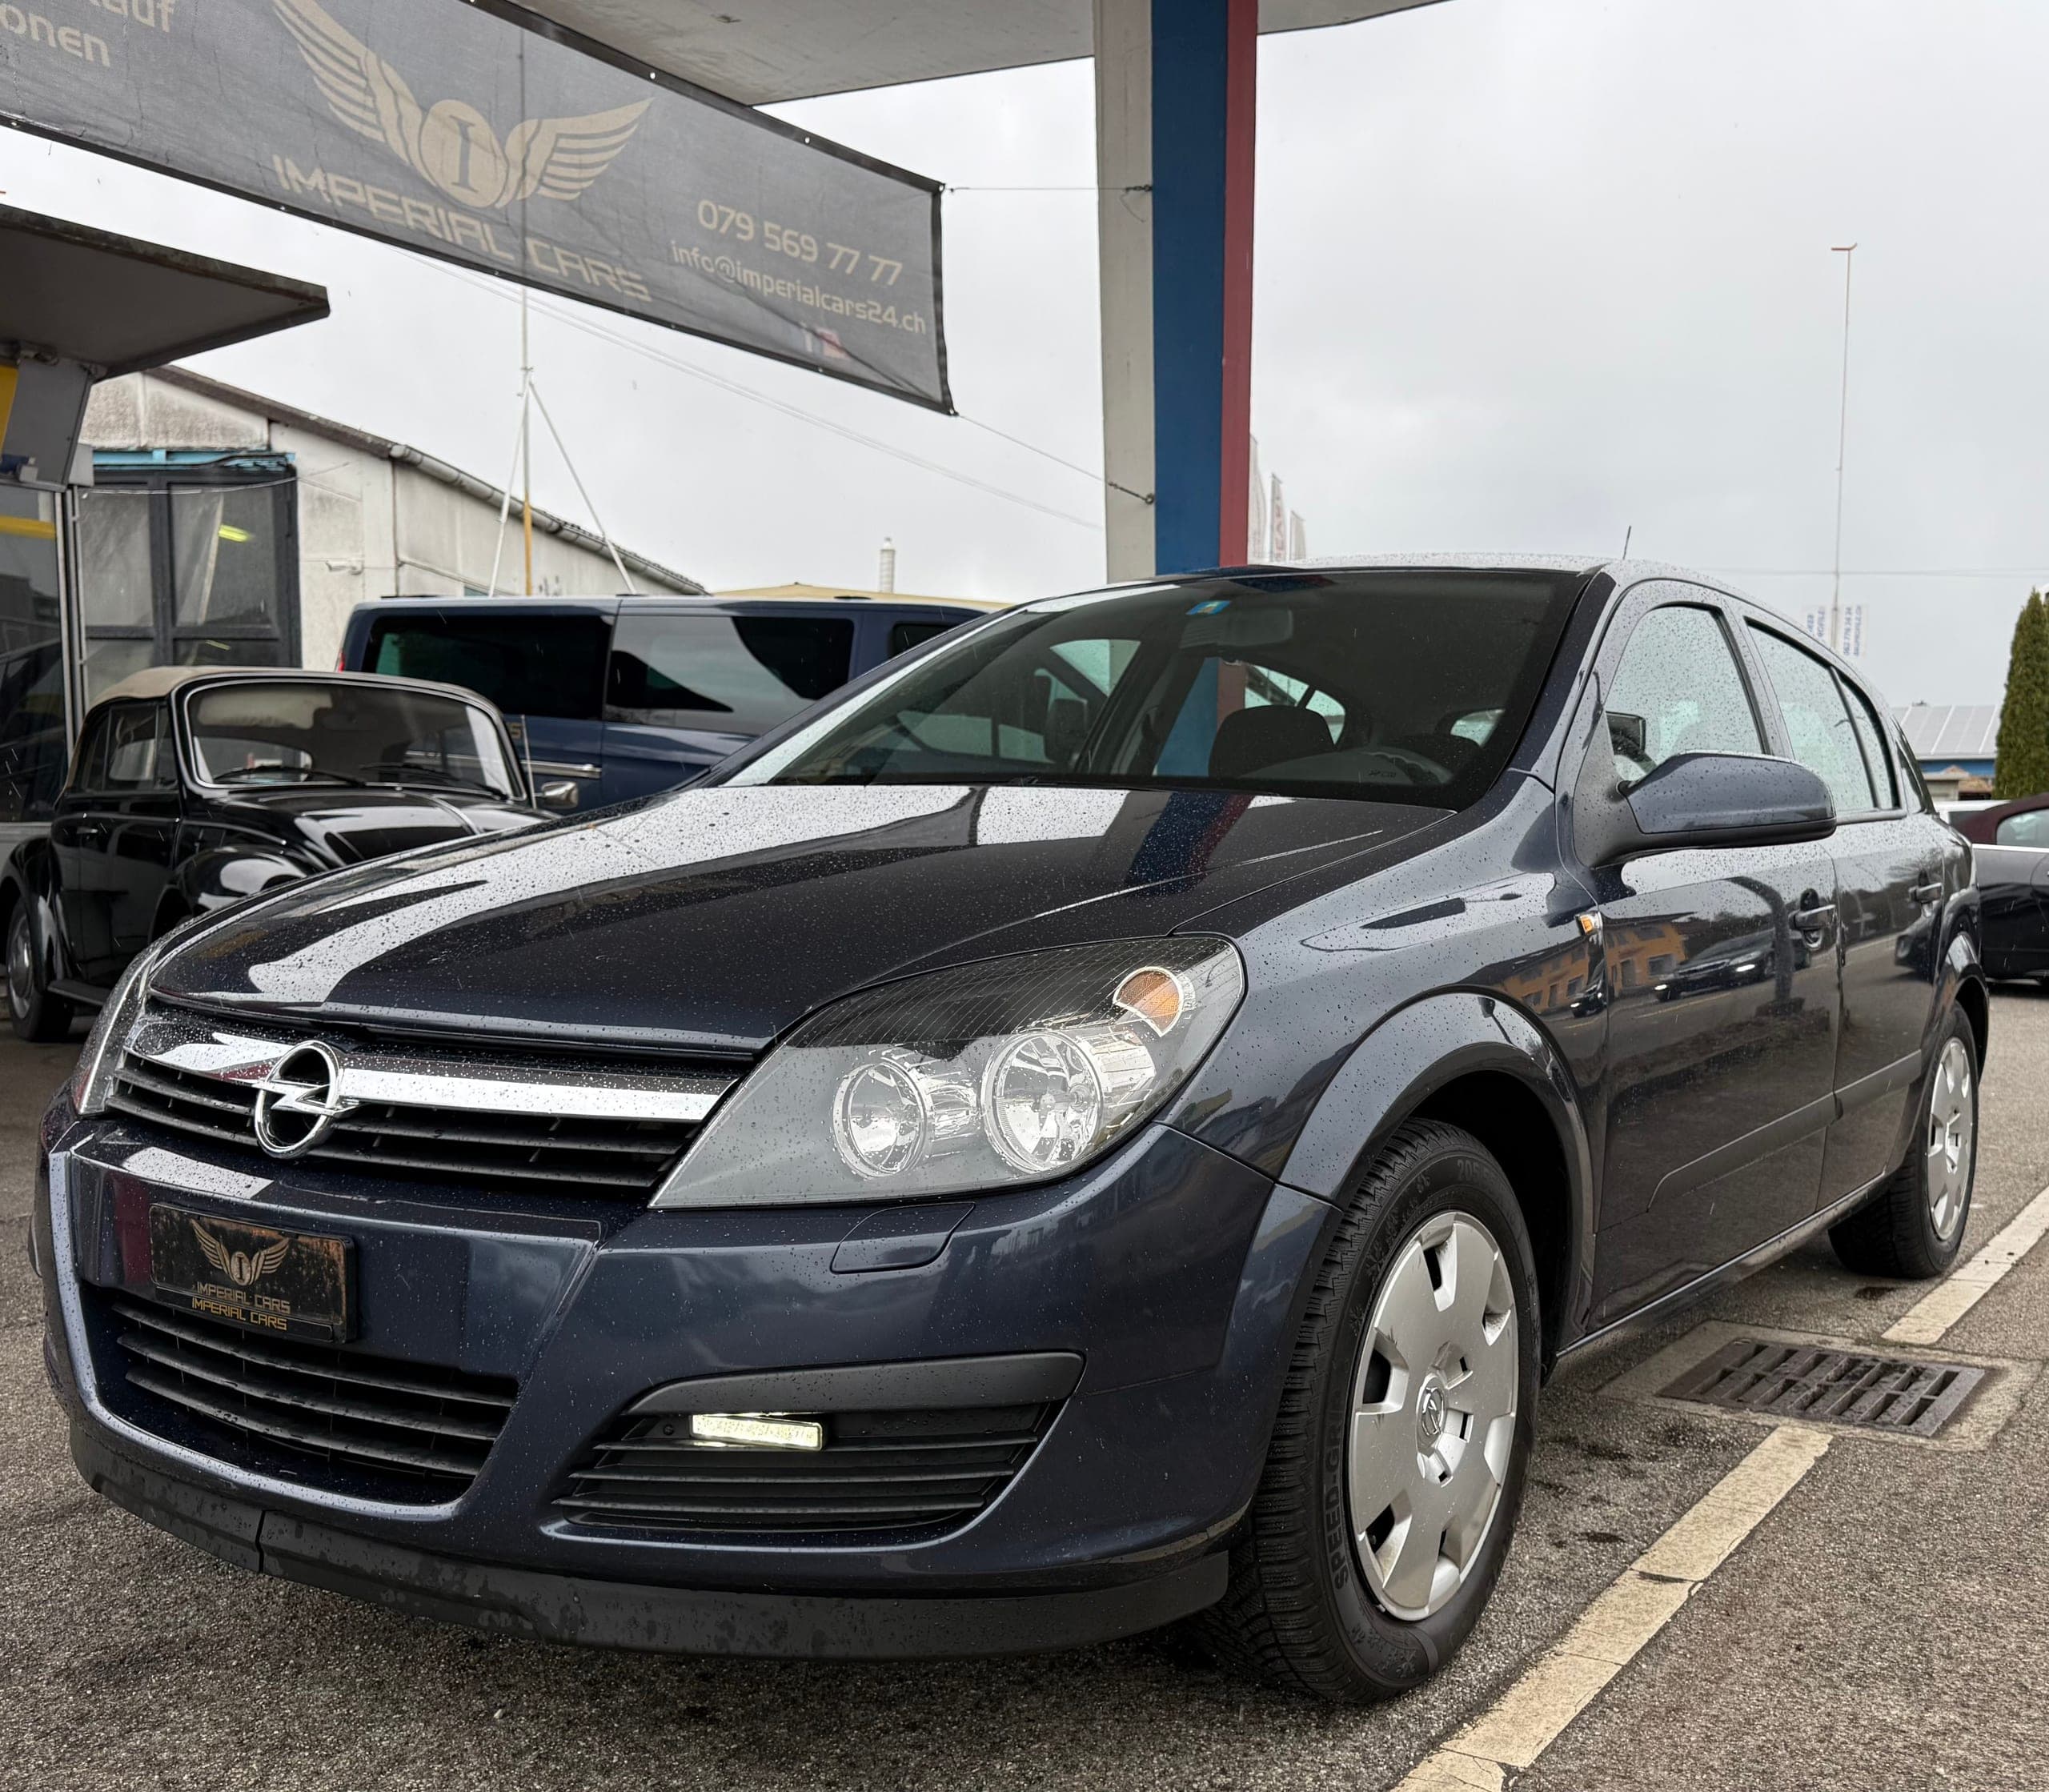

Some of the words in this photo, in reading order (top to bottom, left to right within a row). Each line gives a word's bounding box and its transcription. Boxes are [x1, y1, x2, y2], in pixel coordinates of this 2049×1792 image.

[273, 154, 515, 262] IMPERIAL
[525, 236, 652, 303] CARS
[697, 199, 756, 242] 079
[763, 220, 819, 263] 569
[827, 242, 860, 275] 77
[868, 255, 904, 287] 77
[671, 240, 927, 335] info@imperialcars24.ch
[192, 1297, 247, 1321] IMPERIAL
[250, 1311, 287, 1331] CARS
[197, 1281, 251, 1305] IMPERIAL
[255, 1294, 291, 1314] CARS
